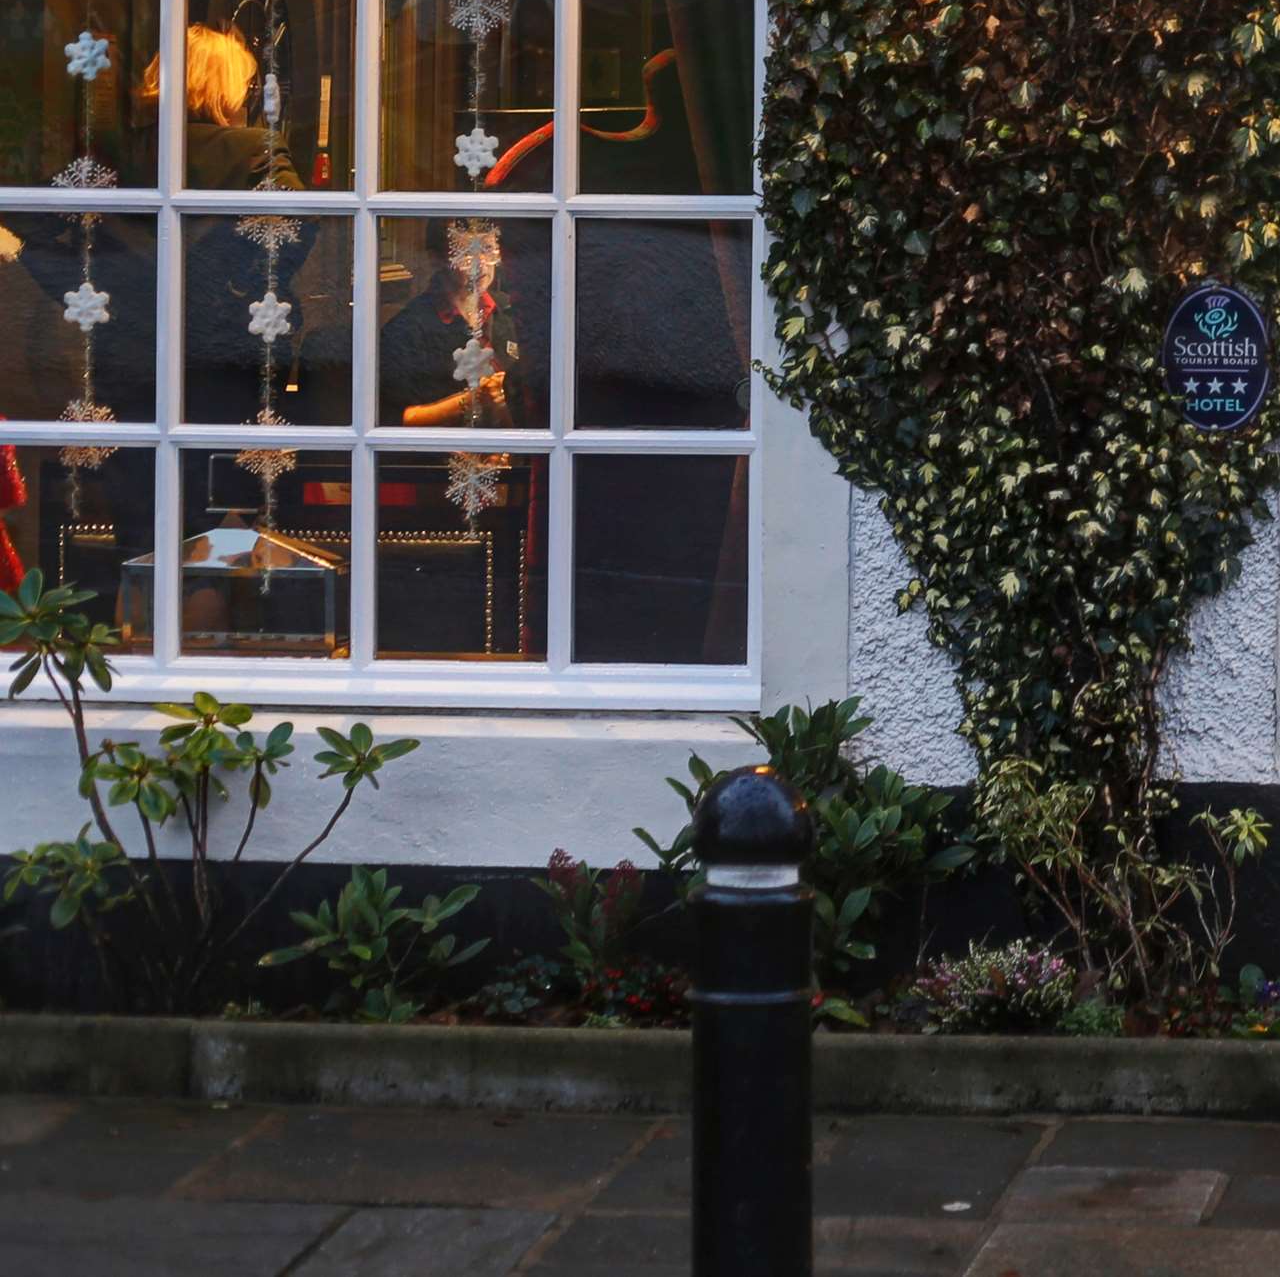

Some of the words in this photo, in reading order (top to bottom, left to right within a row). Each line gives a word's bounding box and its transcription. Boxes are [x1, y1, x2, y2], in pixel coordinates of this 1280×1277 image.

[1173, 335, 1257, 357] Scottish
[1175, 357, 1219, 365] TOURIST
[1223, 357, 1258, 365] BOARD
[1186, 398, 1245, 412] HOTEL
